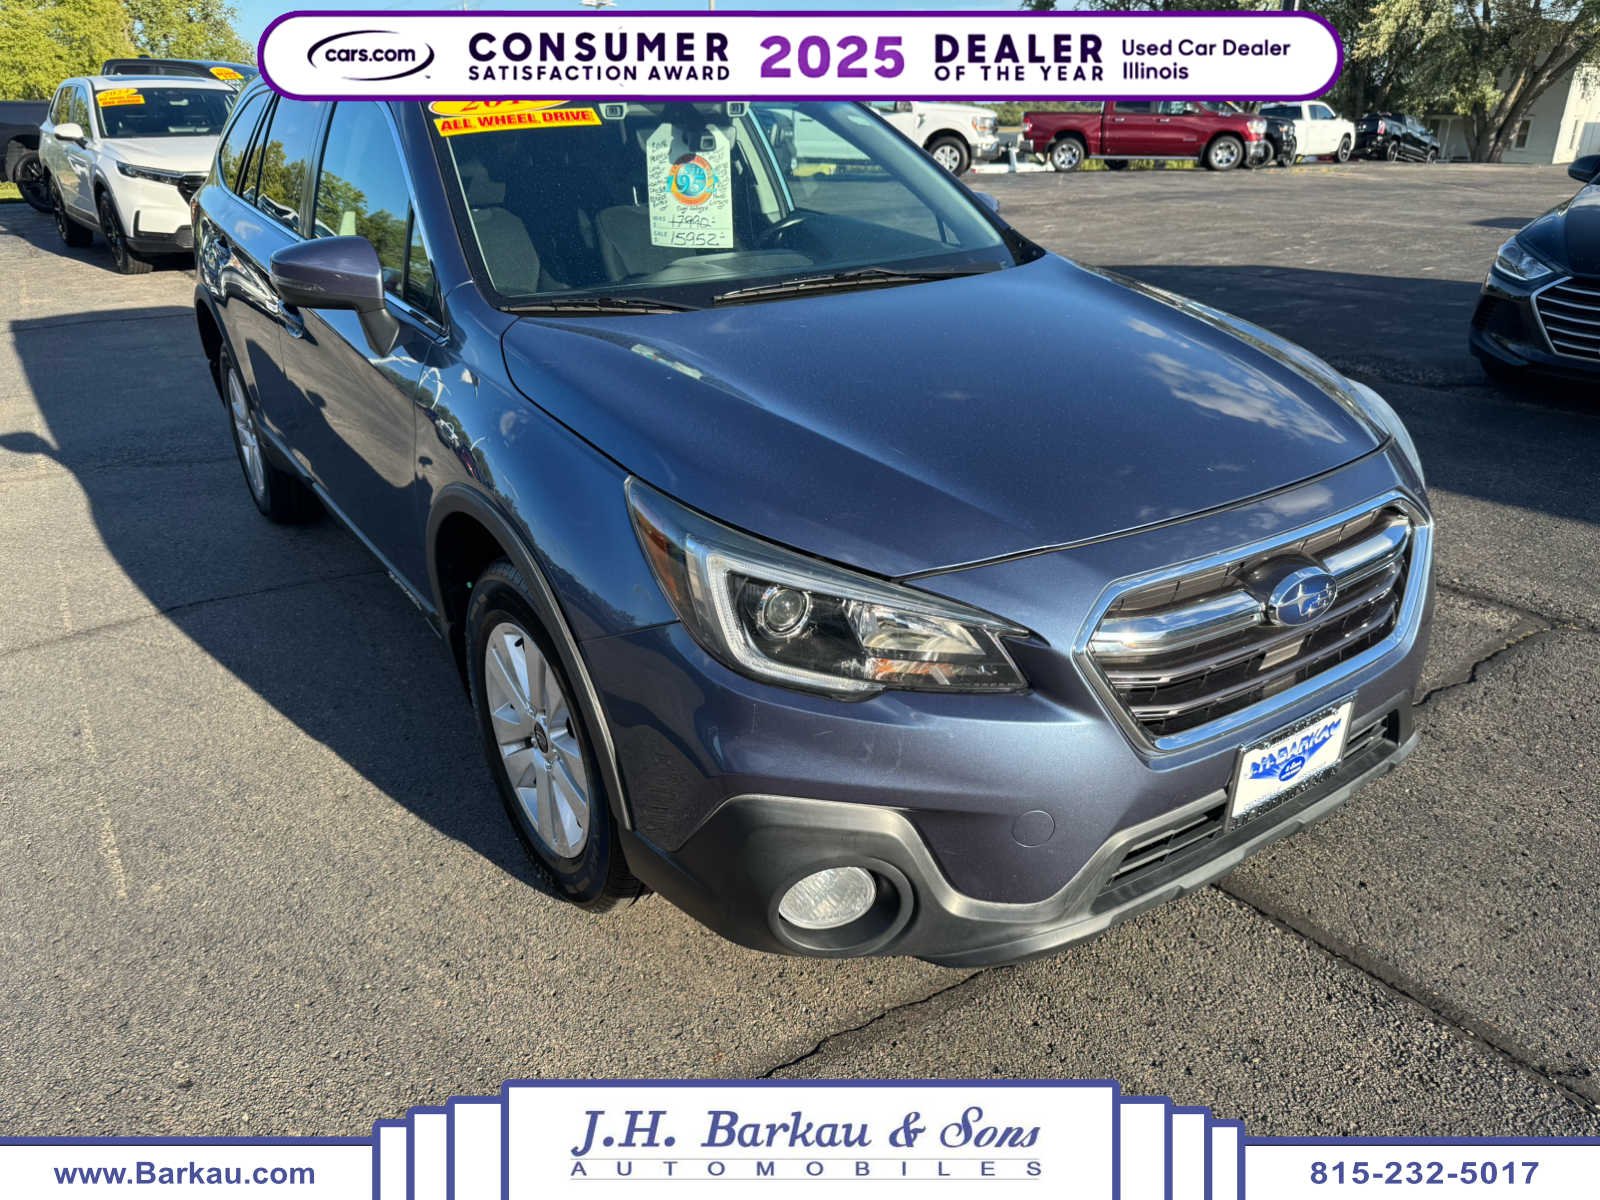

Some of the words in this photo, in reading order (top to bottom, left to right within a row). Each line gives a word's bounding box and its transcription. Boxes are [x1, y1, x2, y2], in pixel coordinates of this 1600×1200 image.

[440, 118, 474, 132] ALL
[477, 113, 539, 128] WHEEL
[542, 110, 594, 123] DRIVE
